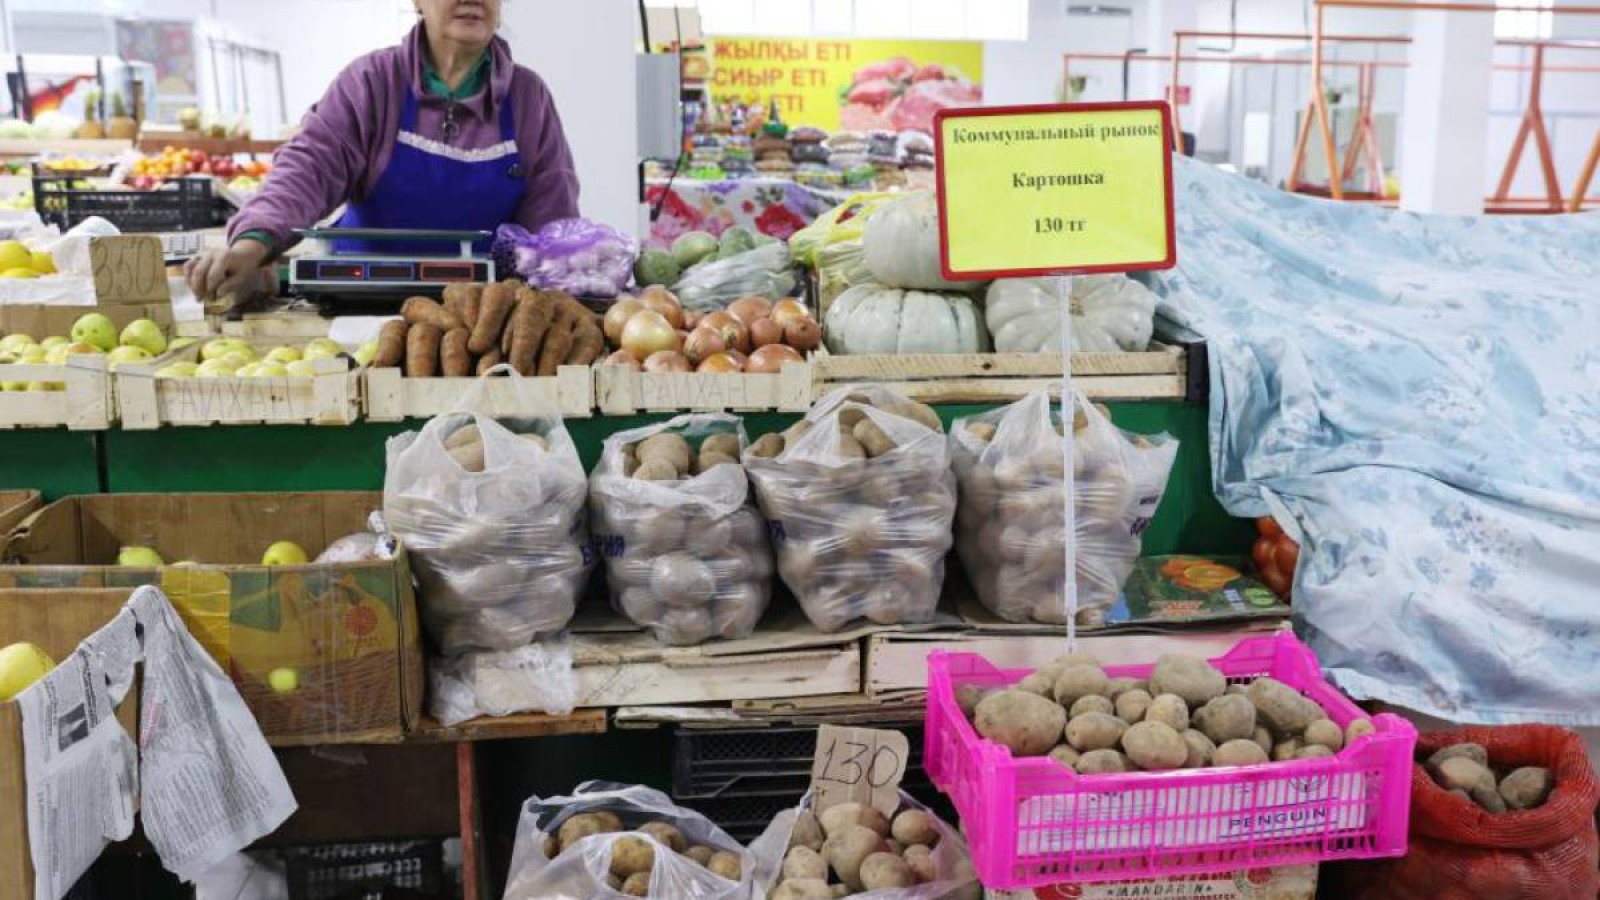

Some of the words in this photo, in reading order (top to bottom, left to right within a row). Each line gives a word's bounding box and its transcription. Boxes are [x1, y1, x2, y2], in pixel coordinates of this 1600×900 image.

[714, 40, 808, 61] ЖЫЛҚЫ
[714, 69, 784, 86] СИЫР
[952, 123, 1096, 145] Коммунальный
[1100, 123, 1160, 142] рынок
[1012, 171, 1105, 191] Картошка
[1034, 217, 1063, 233] 130
[1068, 218, 1087, 232] тг
[817, 737, 900, 788] 130
[1228, 806, 1326, 830] PENGUIN
